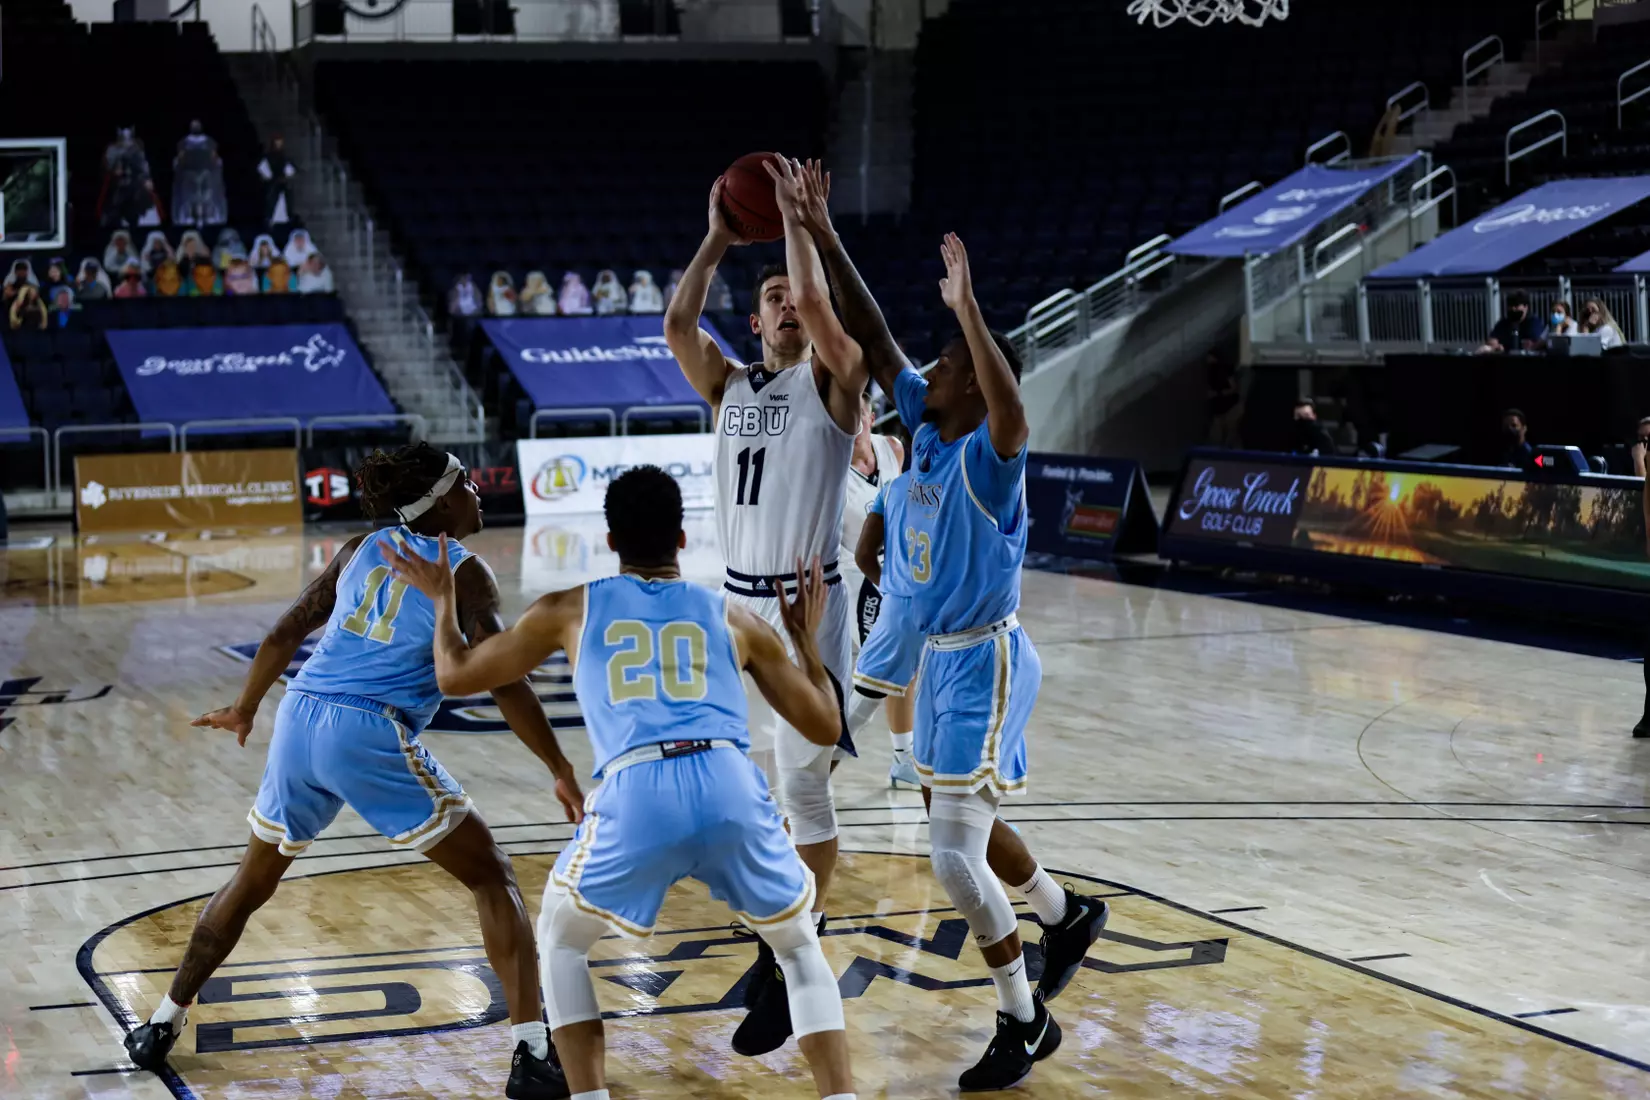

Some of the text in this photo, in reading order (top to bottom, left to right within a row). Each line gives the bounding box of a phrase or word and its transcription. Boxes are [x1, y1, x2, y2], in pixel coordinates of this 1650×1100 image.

[520, 346, 674, 364] GuideSto
[769, 393, 789, 402] WAC
[723, 404, 790, 437] CBU
[736, 446, 766, 506] 11
[1242, 470, 1300, 515] Creek
[1201, 511, 1265, 537] GOLF CLUB
[339, 564, 410, 645] 11
[603, 618, 709, 706] 20
